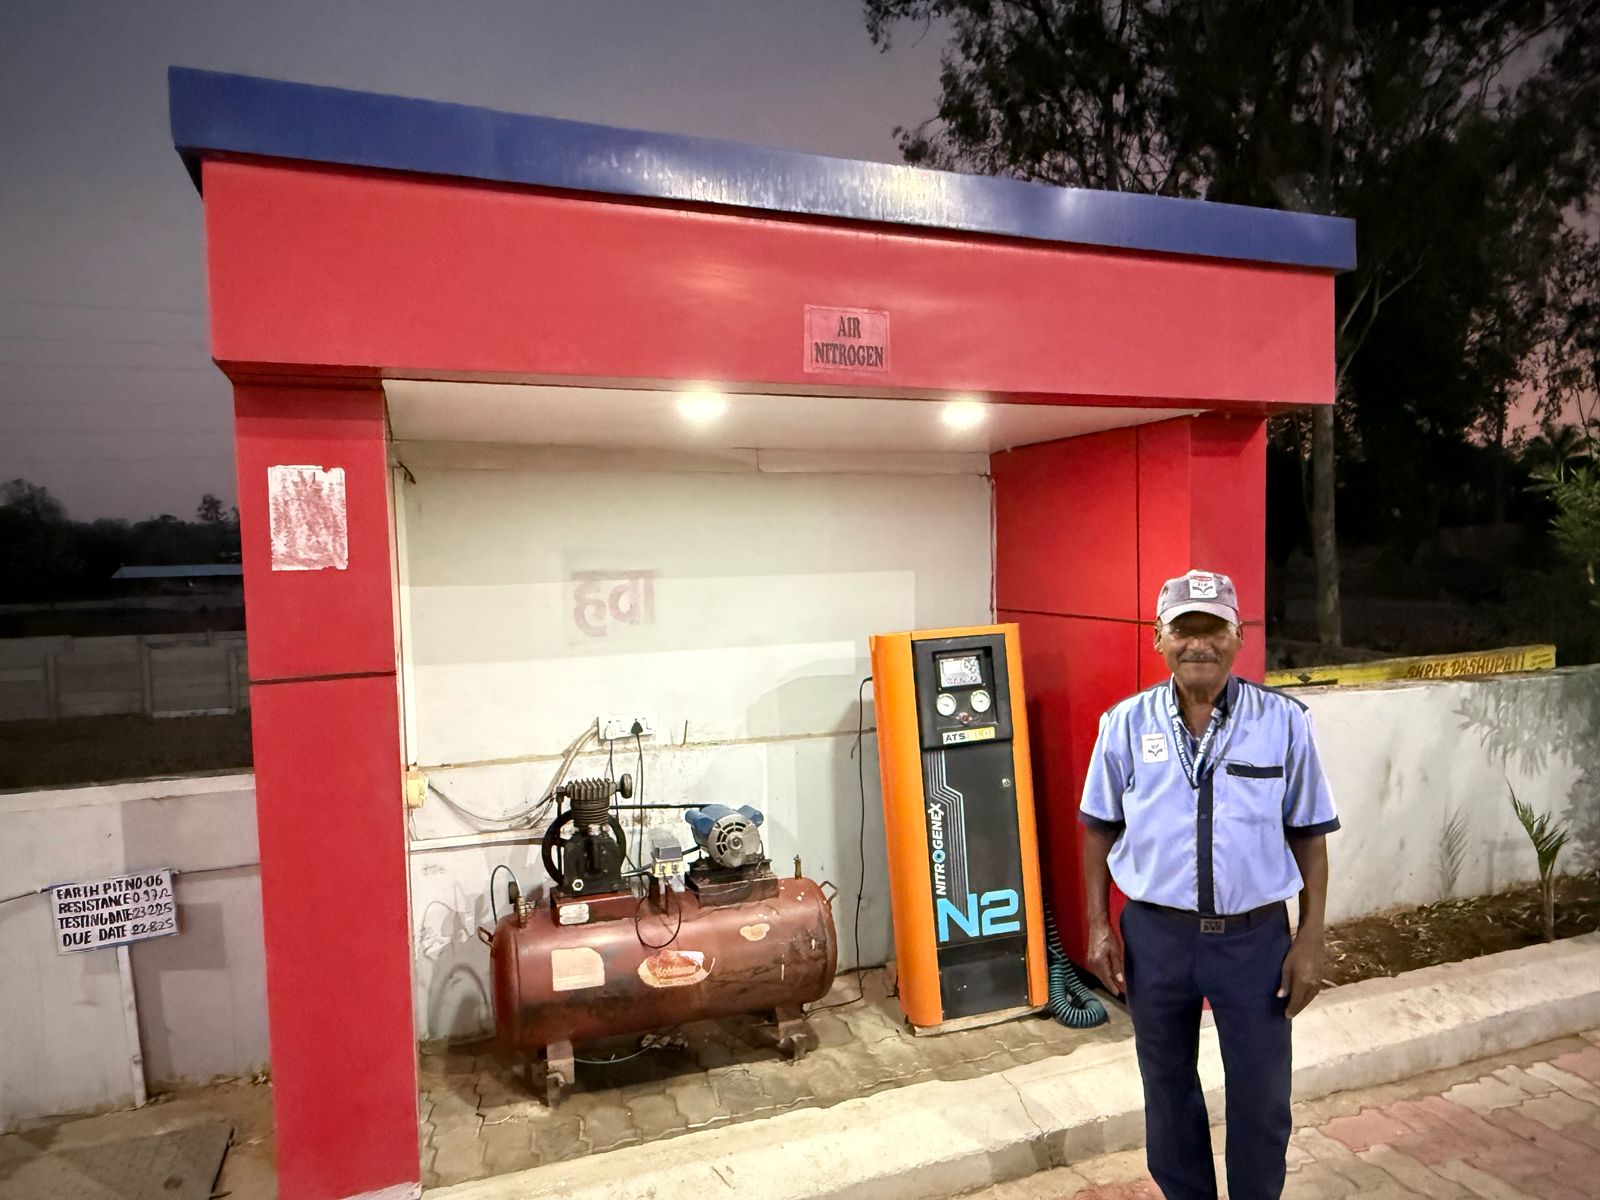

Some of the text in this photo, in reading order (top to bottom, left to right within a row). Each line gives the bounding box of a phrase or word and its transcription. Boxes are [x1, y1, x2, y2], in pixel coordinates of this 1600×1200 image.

[838, 315, 862, 339] AIR
[814, 342, 884, 368] NITROGEN
[571, 569, 658, 637] हवा
[945, 732, 967, 743] ATS
[927, 802, 947, 896] NITROGENEX
[56, 884, 99, 900] EARTH
[102, 879, 125, 896] PIT
[936, 888, 1021, 942] N2
[62, 931, 92, 947] DUE
[98, 924, 128, 941] DATE
